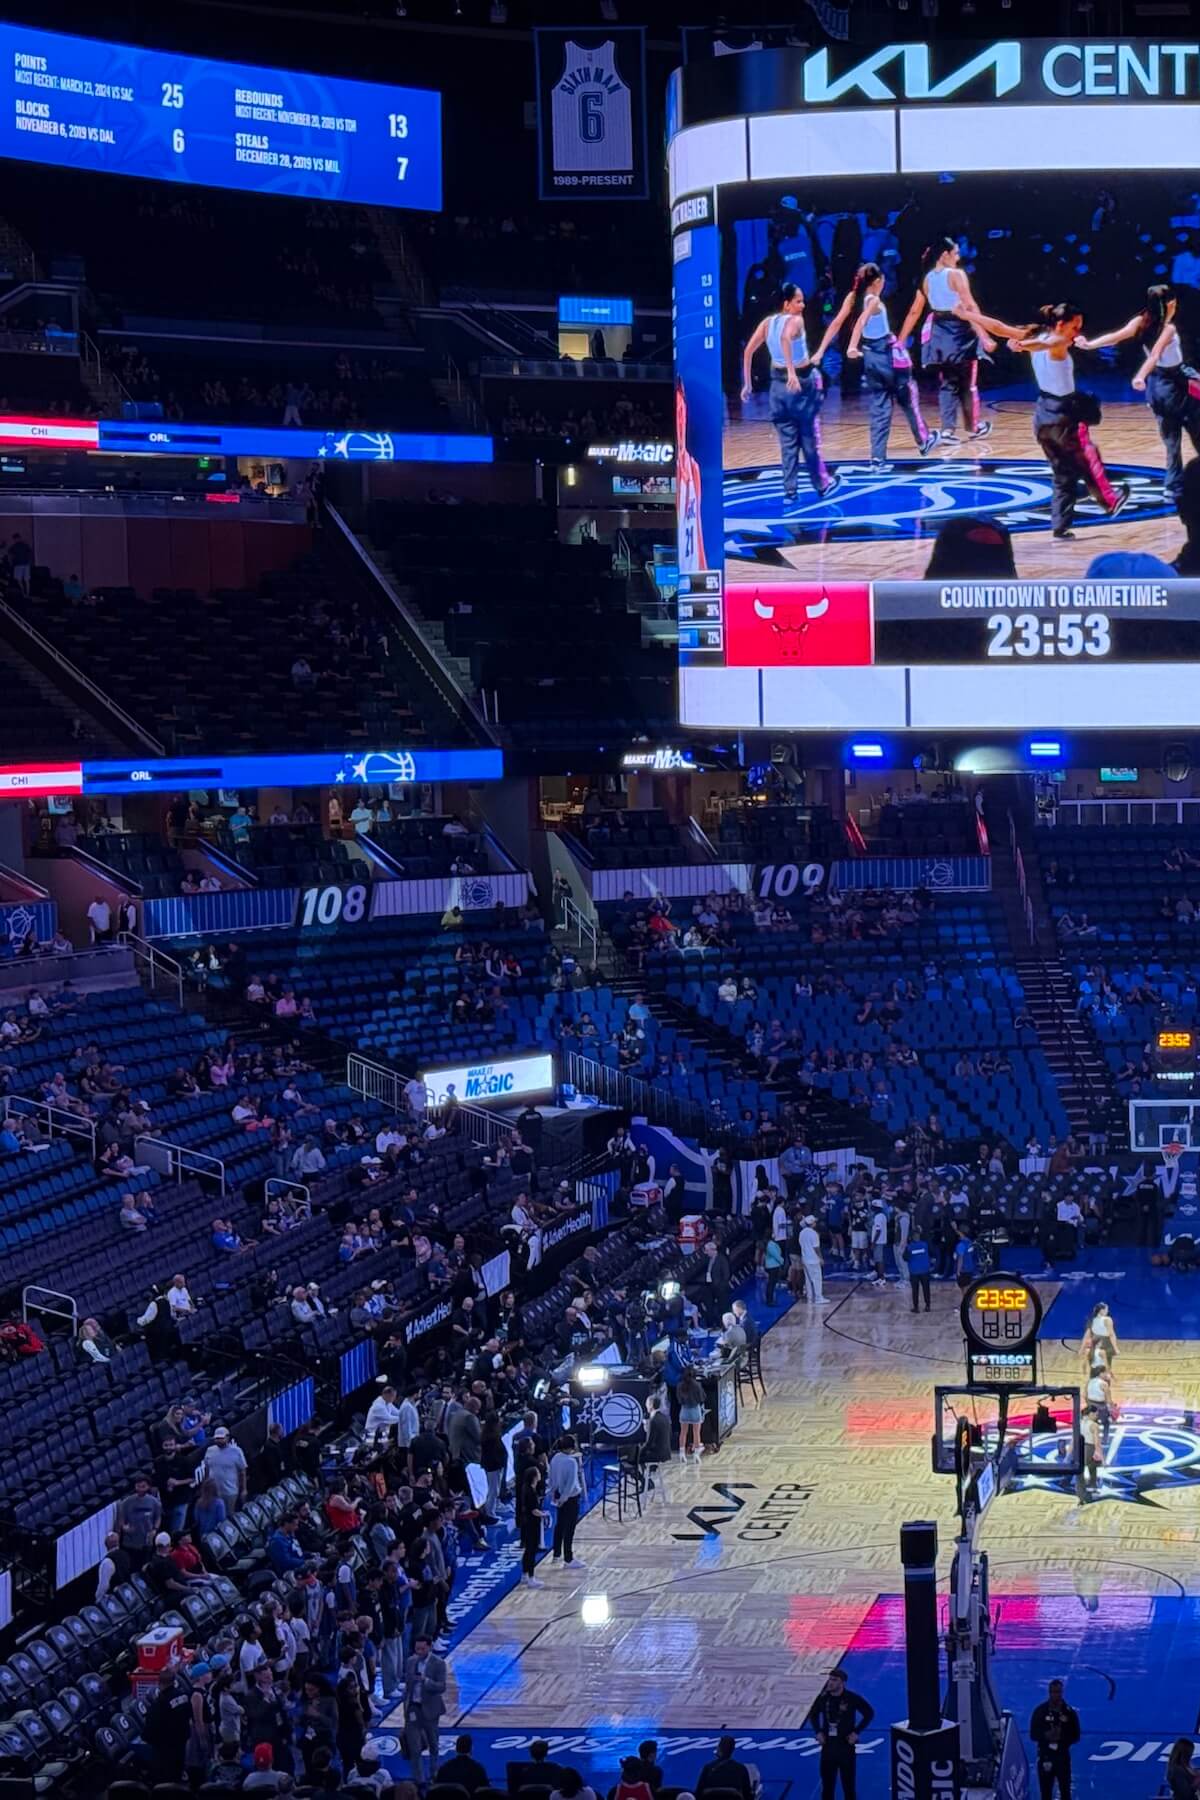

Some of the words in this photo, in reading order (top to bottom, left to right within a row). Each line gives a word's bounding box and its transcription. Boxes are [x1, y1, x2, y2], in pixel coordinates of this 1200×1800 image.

[15, 53, 47, 71] POINTS
[15, 69, 33, 85] MOST
[33, 72, 60, 89] RECENT:
[60, 77, 83, 94] MARCH
[111, 87, 120, 100] VS
[560, 66, 592, 95] SIXTH
[592, 67, 622, 95] MAN
[161, 82, 185, 109] 25
[235, 88, 284, 108] REBOUNDS
[16, 99, 50, 118] BLOCKS
[235, 104, 252, 118] MOST
[253, 107, 278, 122] RECENT:
[278, 110, 310, 127] NOVEMBER
[336, 118, 344, 131] VS
[578, 91, 605, 143] 6
[16, 116, 59, 136] NOVEMBER
[59, 124, 68, 139] 6,
[69, 125, 87, 139] 2019
[88, 127, 99, 141] VS
[99, 130, 116, 145] DAL
[388, 114, 408, 138] 13
[172, 129, 185, 154] 6
[235, 132, 269, 149] STEALS
[236, 148, 278, 165] DECEMBER
[279, 154, 293, 169] 28,
[293, 155, 312, 171] 2019
[313, 157, 324, 171] VS
[397, 156, 409, 180] 7
[553, 175, 634, 186] 1989-PRESENT
[31, 427, 48, 436] CHI
[149, 433, 170, 443] ORL
[941, 585, 1045, 609] COUNTDOWN
[1047, 586, 1070, 607] TO
[1073, 584, 1168, 608] GAMETIME:
[987, 613, 1111, 657] 23:53
[11, 776, 28, 786] CHI
[131, 770, 152, 781] ORL
[759, 863, 825, 898] 109
[302, 884, 367, 926] 108
[975, 1288, 1027, 1309] 23:52
[989, 1354, 1033, 1365] TISSOT
[737, 1482, 819, 1541] CENTER
